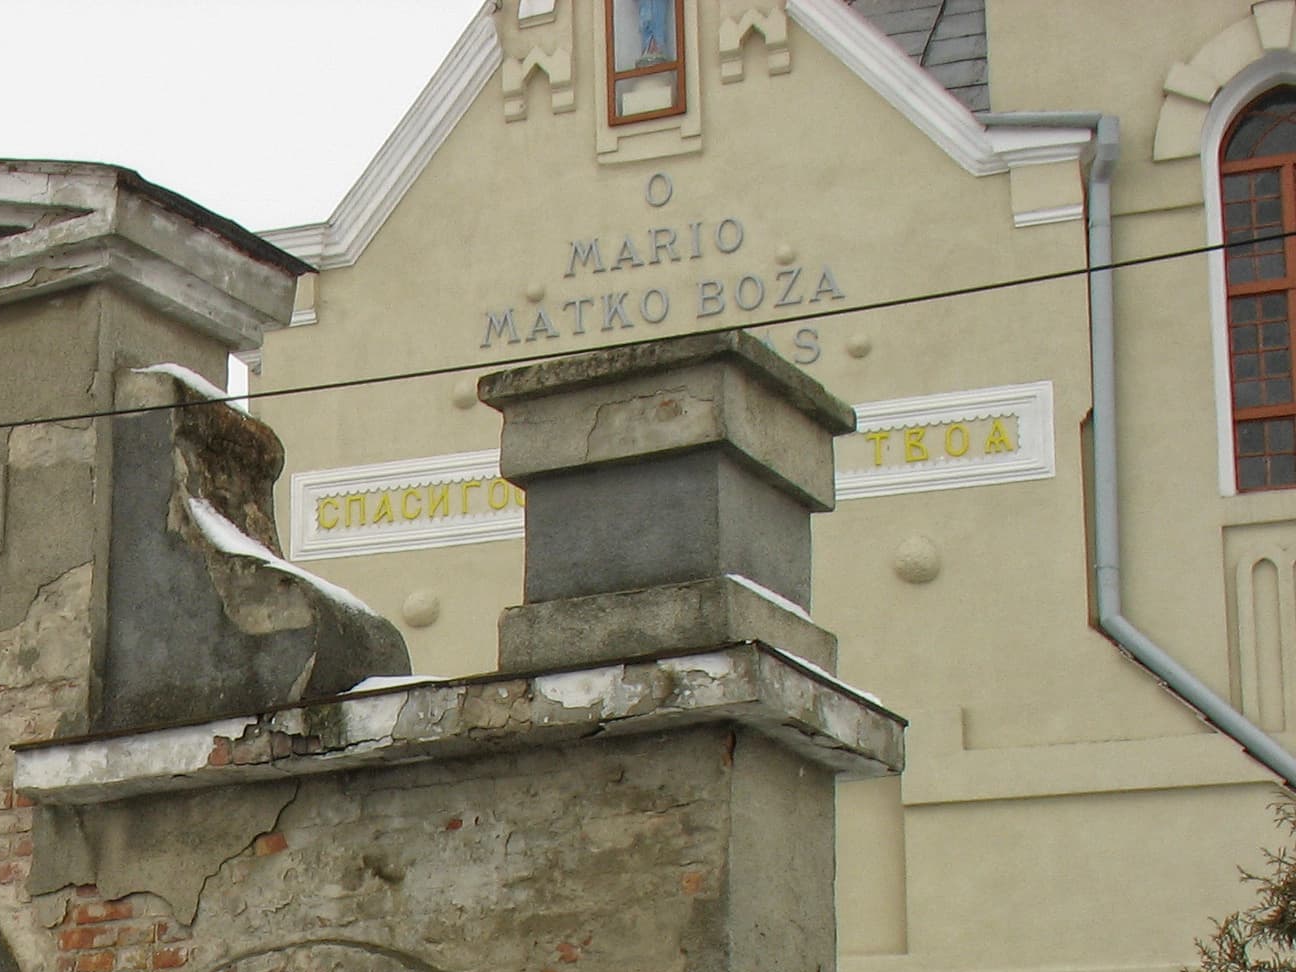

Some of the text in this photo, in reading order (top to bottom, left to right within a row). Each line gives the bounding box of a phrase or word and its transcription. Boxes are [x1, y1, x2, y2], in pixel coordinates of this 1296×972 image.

[645, 171, 674, 208] O
[562, 217, 745, 278] MARIO
[479, 286, 671, 349] MATKO
